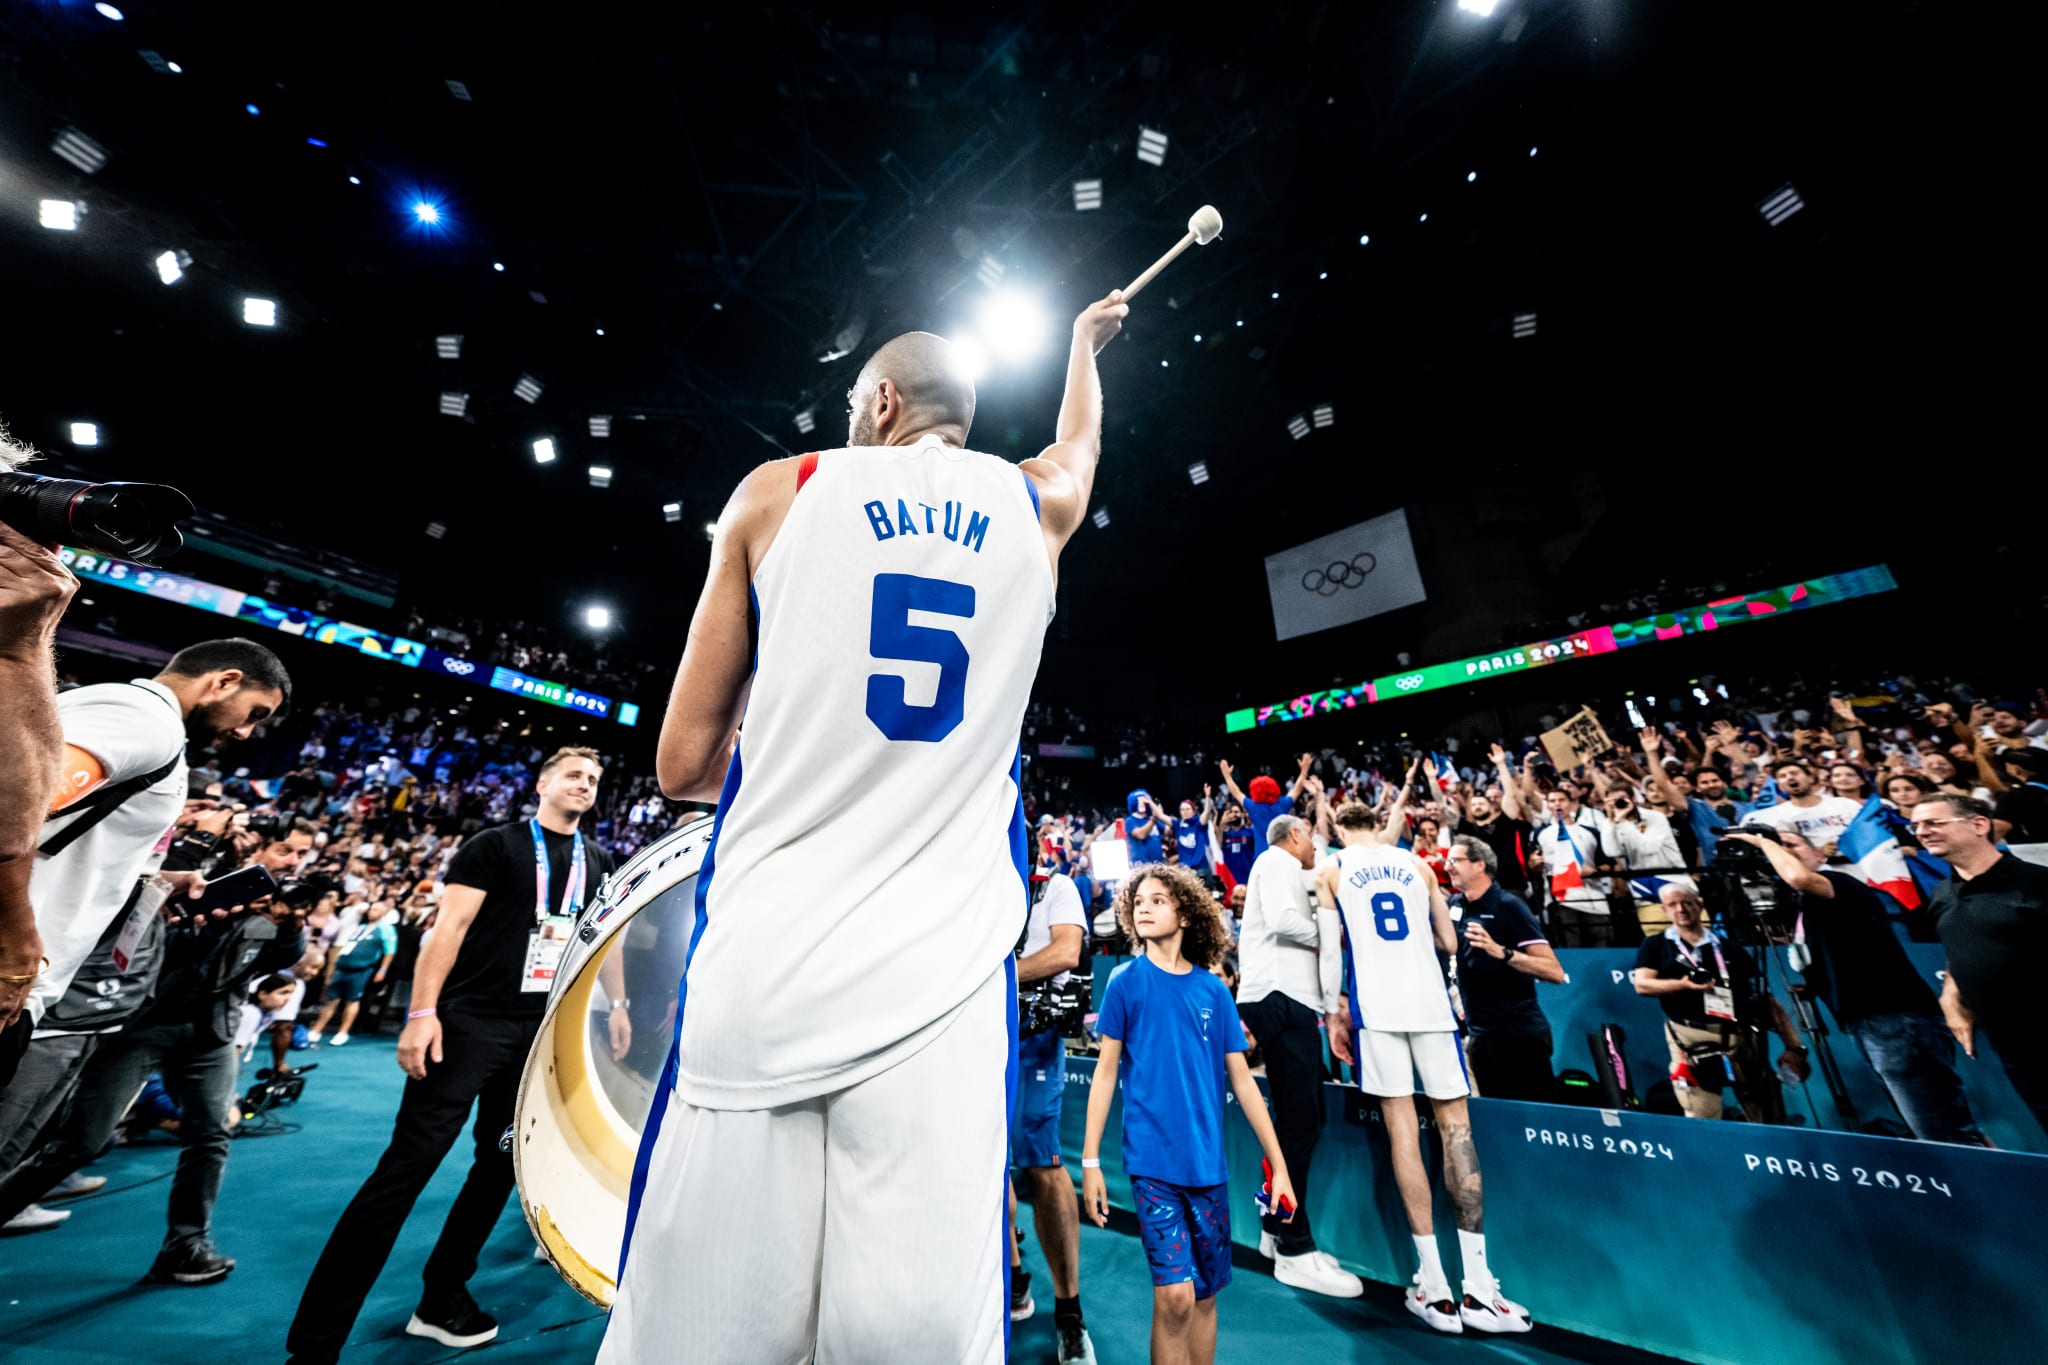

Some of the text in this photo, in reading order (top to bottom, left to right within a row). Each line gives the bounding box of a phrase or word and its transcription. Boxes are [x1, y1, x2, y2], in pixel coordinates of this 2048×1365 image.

[864, 498, 990, 553] BATUM
[58, 549, 212, 602] ARIS 2024
[866, 572, 976, 742] 5
[1465, 638, 1590, 676] PARIS 2024
[511, 677, 607, 713] PARIS 2024
[1349, 866, 1415, 889] CORDINIER
[1371, 891, 1410, 941] 8
[1524, 1127, 1674, 1161] PARIS 2024
[1743, 1153, 1953, 1198] PARIS 2024
